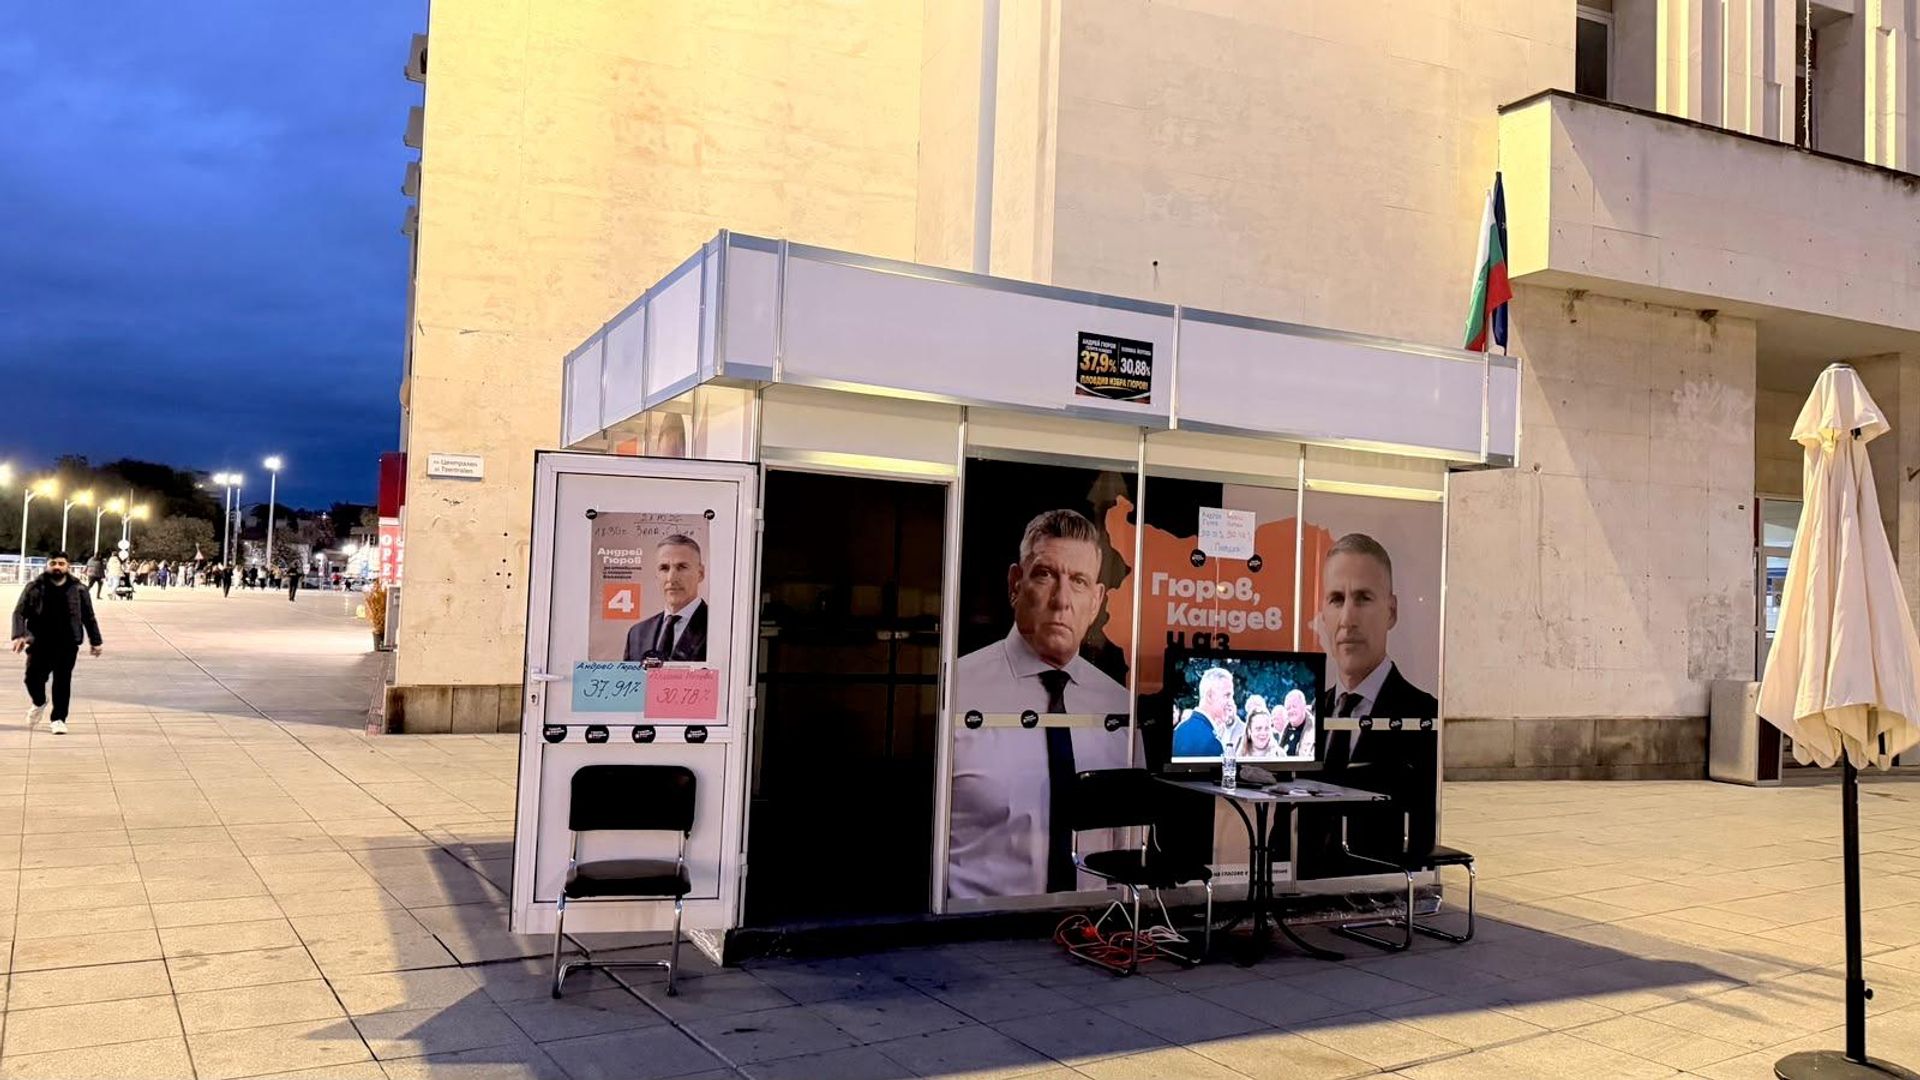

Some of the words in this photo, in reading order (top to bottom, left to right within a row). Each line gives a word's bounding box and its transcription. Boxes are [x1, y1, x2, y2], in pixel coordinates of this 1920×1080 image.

[597, 547, 643, 558] Андрей
[603, 556, 642, 566] Гюров
[1152, 572, 1261, 605] Гюров,
[608, 589, 634, 613] 4
[1167, 602, 1283, 634] Кандев
[575, 661, 613, 673] Андрей
